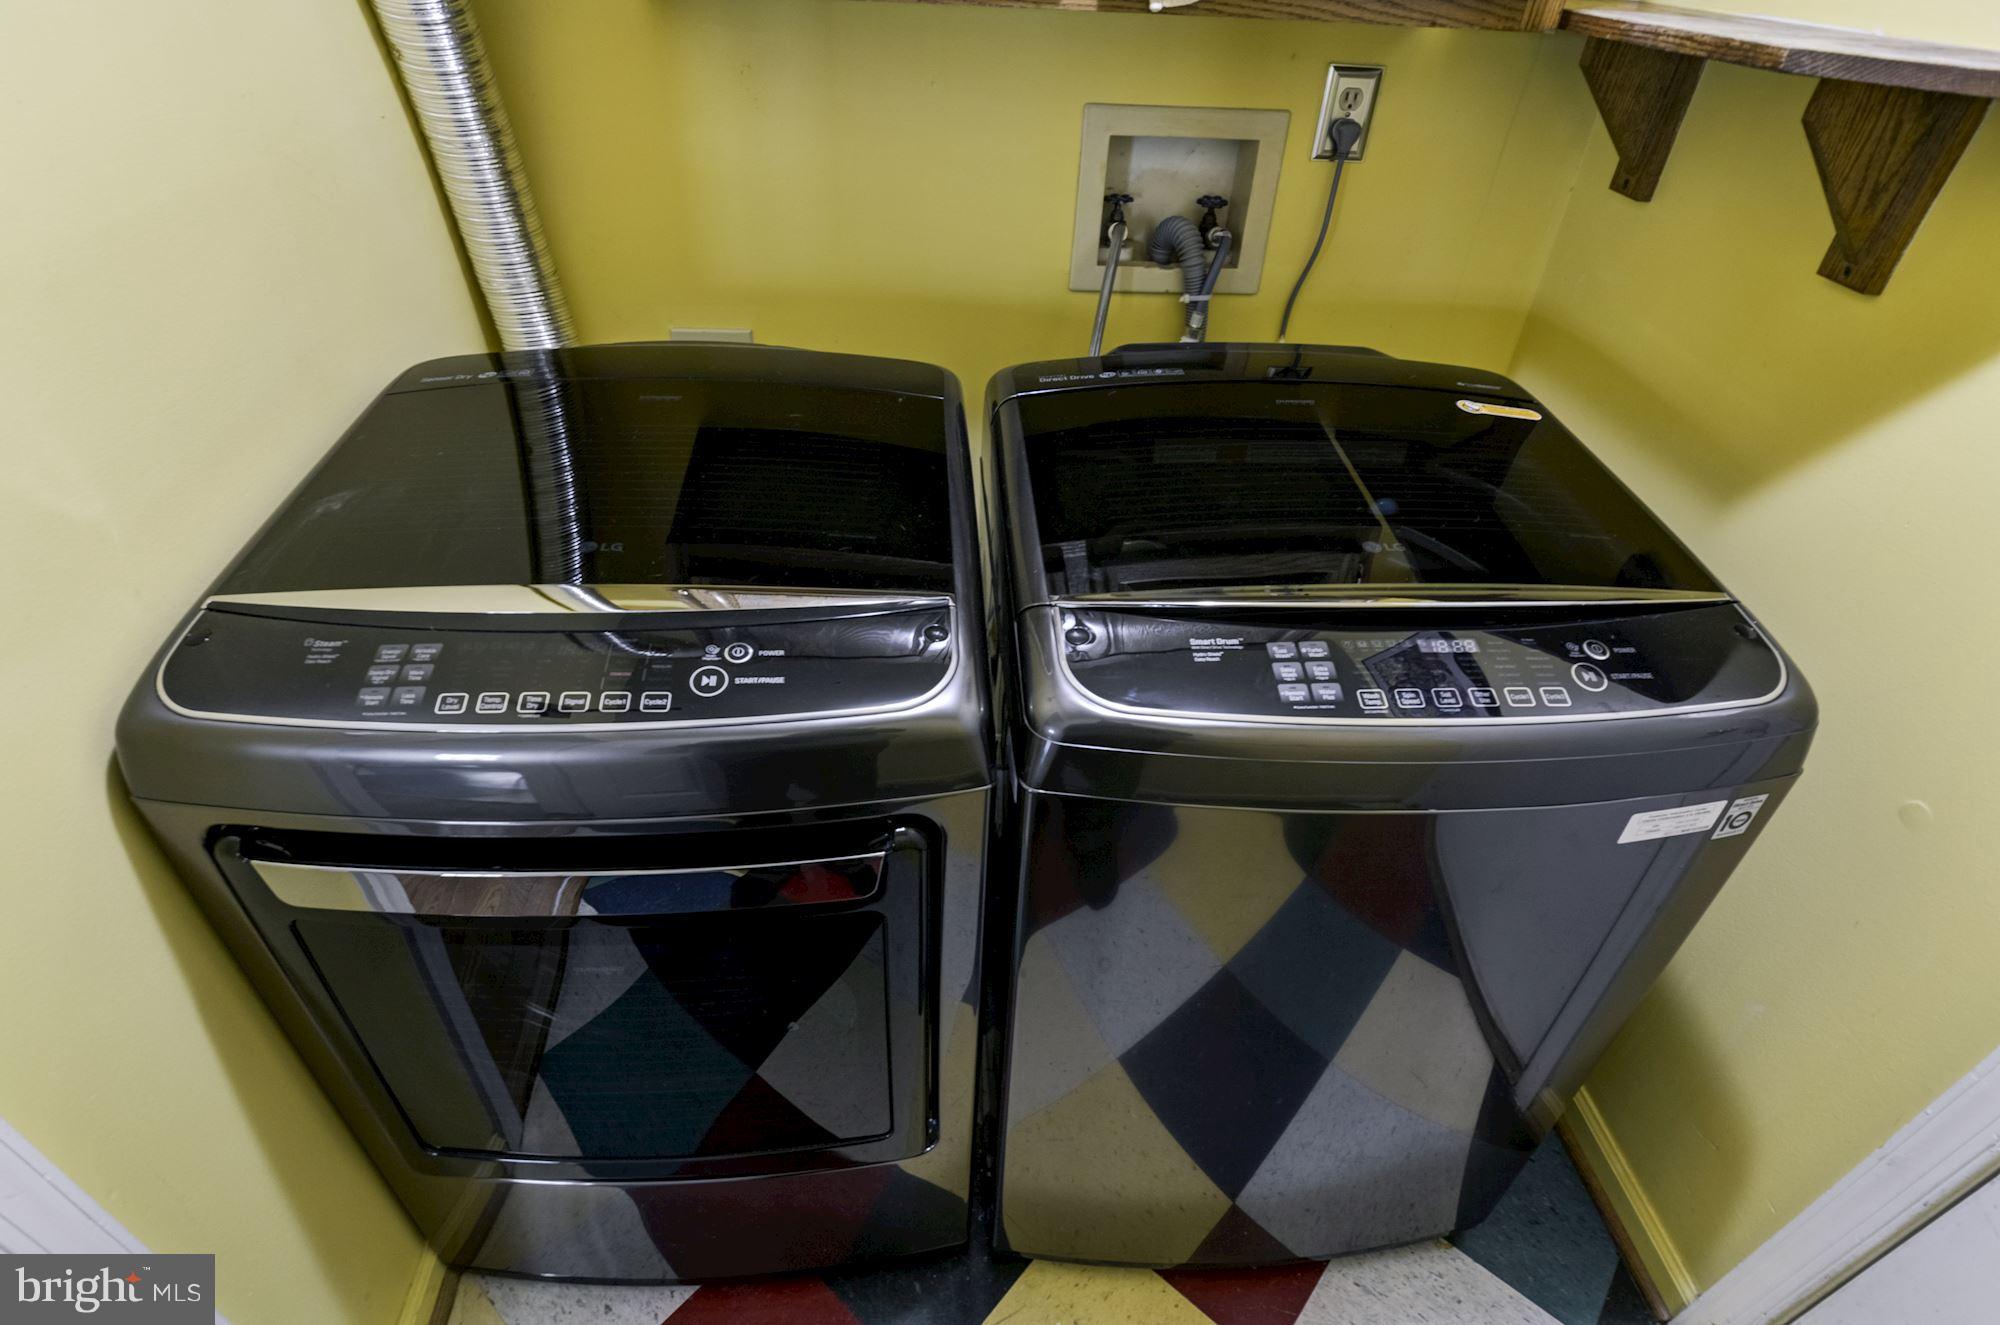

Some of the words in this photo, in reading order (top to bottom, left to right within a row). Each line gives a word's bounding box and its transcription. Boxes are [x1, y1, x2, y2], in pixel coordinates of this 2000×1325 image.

[600, 542, 625, 552] LG
[1382, 542, 1406, 551] LG
[1189, 637, 1216, 646] Smart
[734, 676, 785, 684] START/PAUSE
